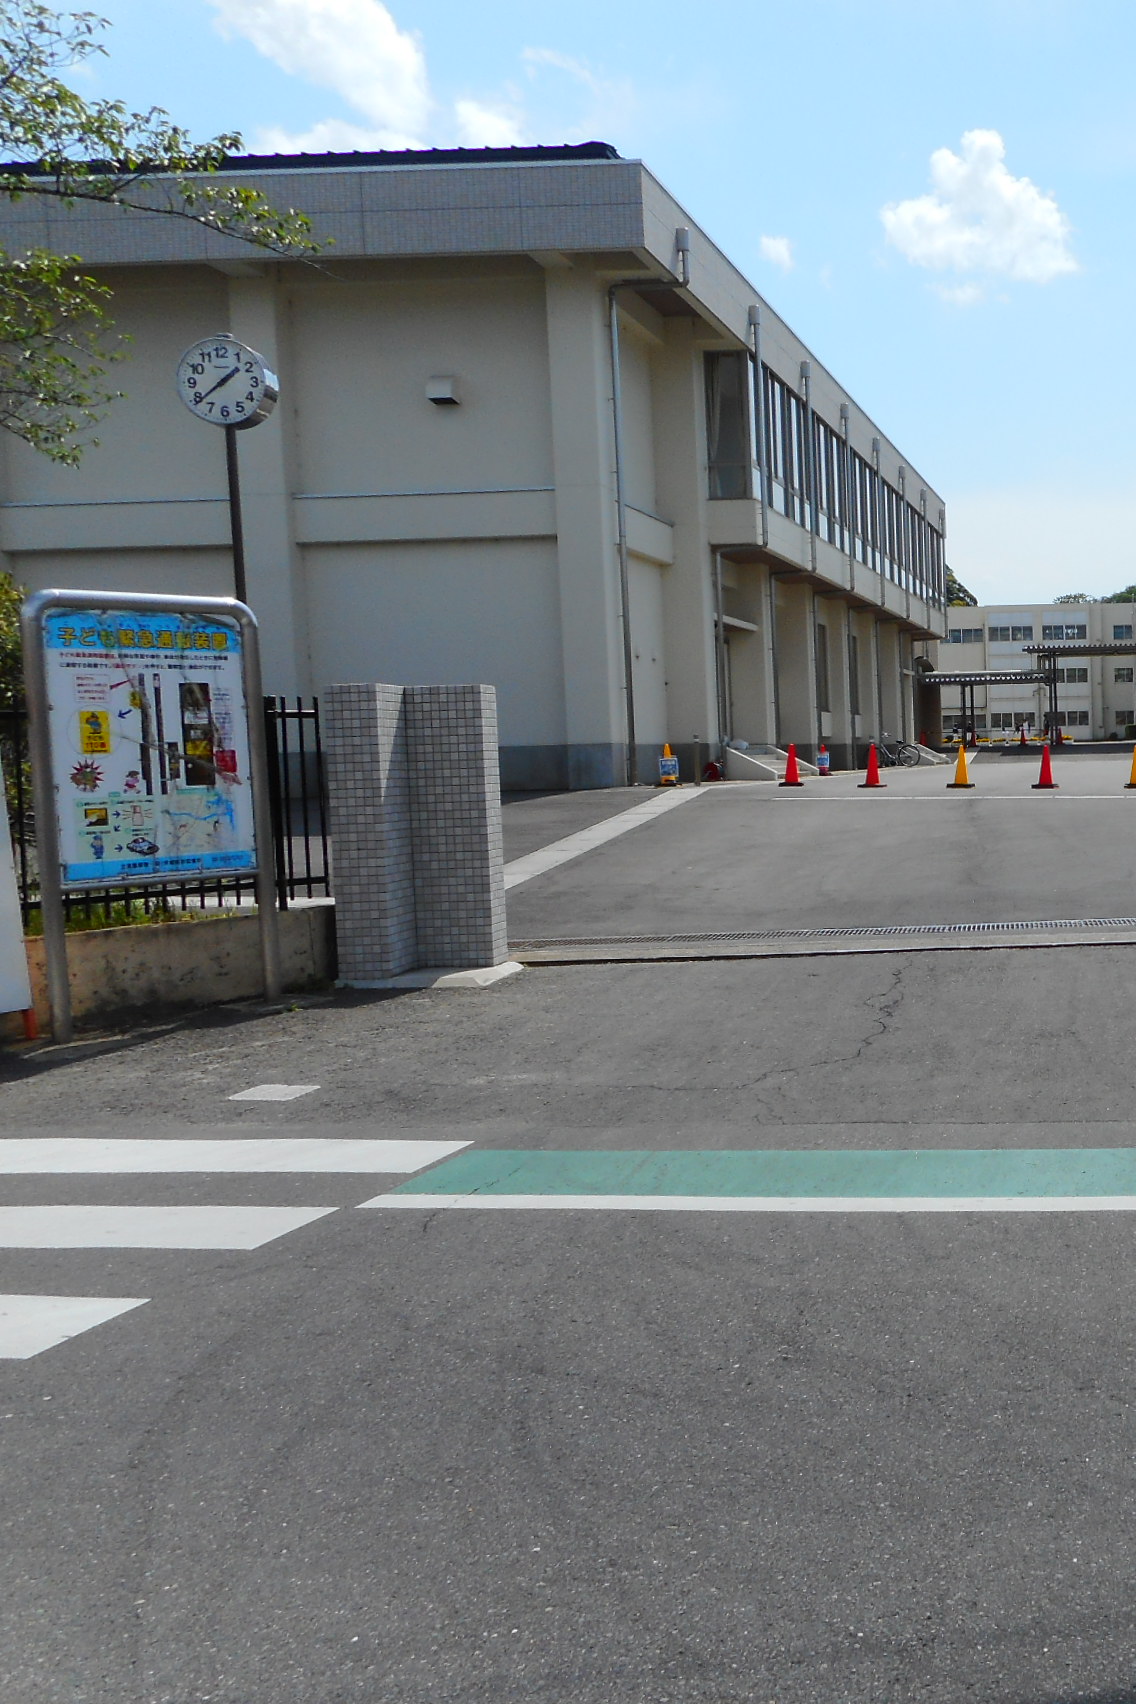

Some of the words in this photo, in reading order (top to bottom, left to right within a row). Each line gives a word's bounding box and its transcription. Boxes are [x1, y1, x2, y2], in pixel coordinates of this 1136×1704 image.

[200, 352, 212, 362] 11
[213, 347, 228, 358] 12
[234, 353, 240, 363] 1
[189, 364, 204, 374] 10
[245, 362, 254, 372] 2
[187, 377, 196, 388] 9
[250, 376, 259, 388] 3
[246, 391, 254, 402] 4
[206, 402, 215, 413] 7
[220, 406, 230, 417] 6
[236, 402, 245, 413] 5
